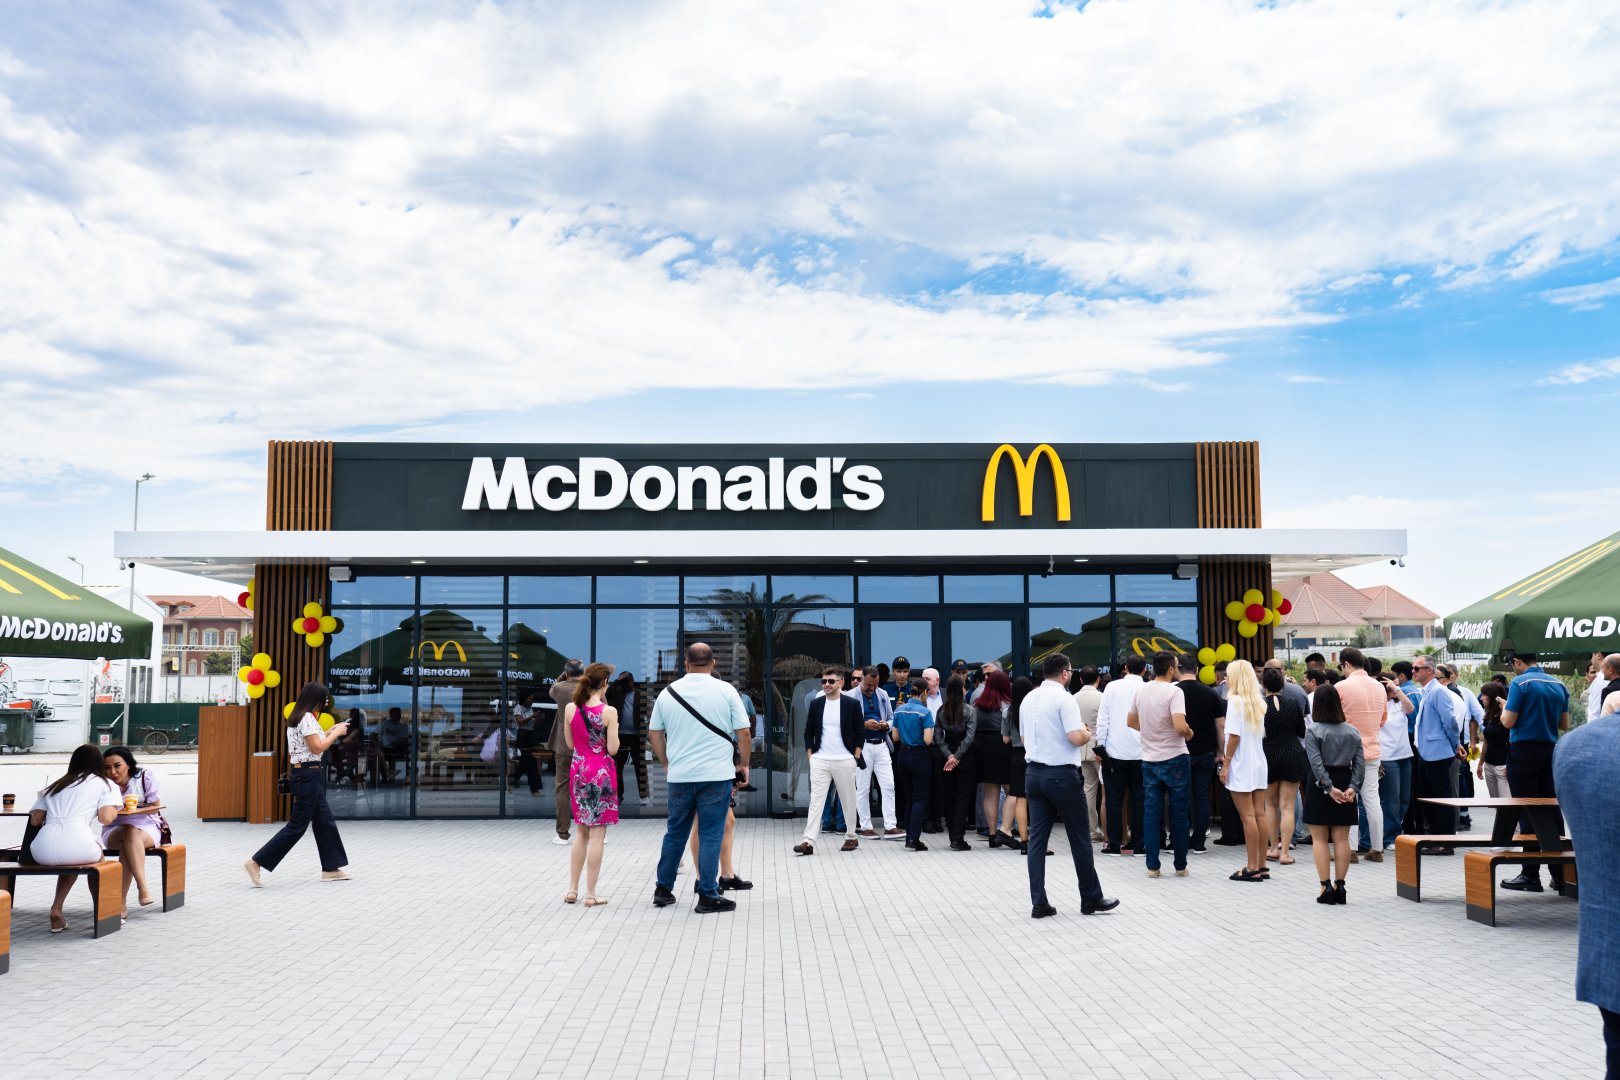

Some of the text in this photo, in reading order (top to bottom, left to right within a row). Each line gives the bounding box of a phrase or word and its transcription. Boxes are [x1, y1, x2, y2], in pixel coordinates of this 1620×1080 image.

[461, 456, 885, 511] McDonald's
[0, 615, 122, 644] McDonald's
[1449, 619, 1494, 640] McDonald's
